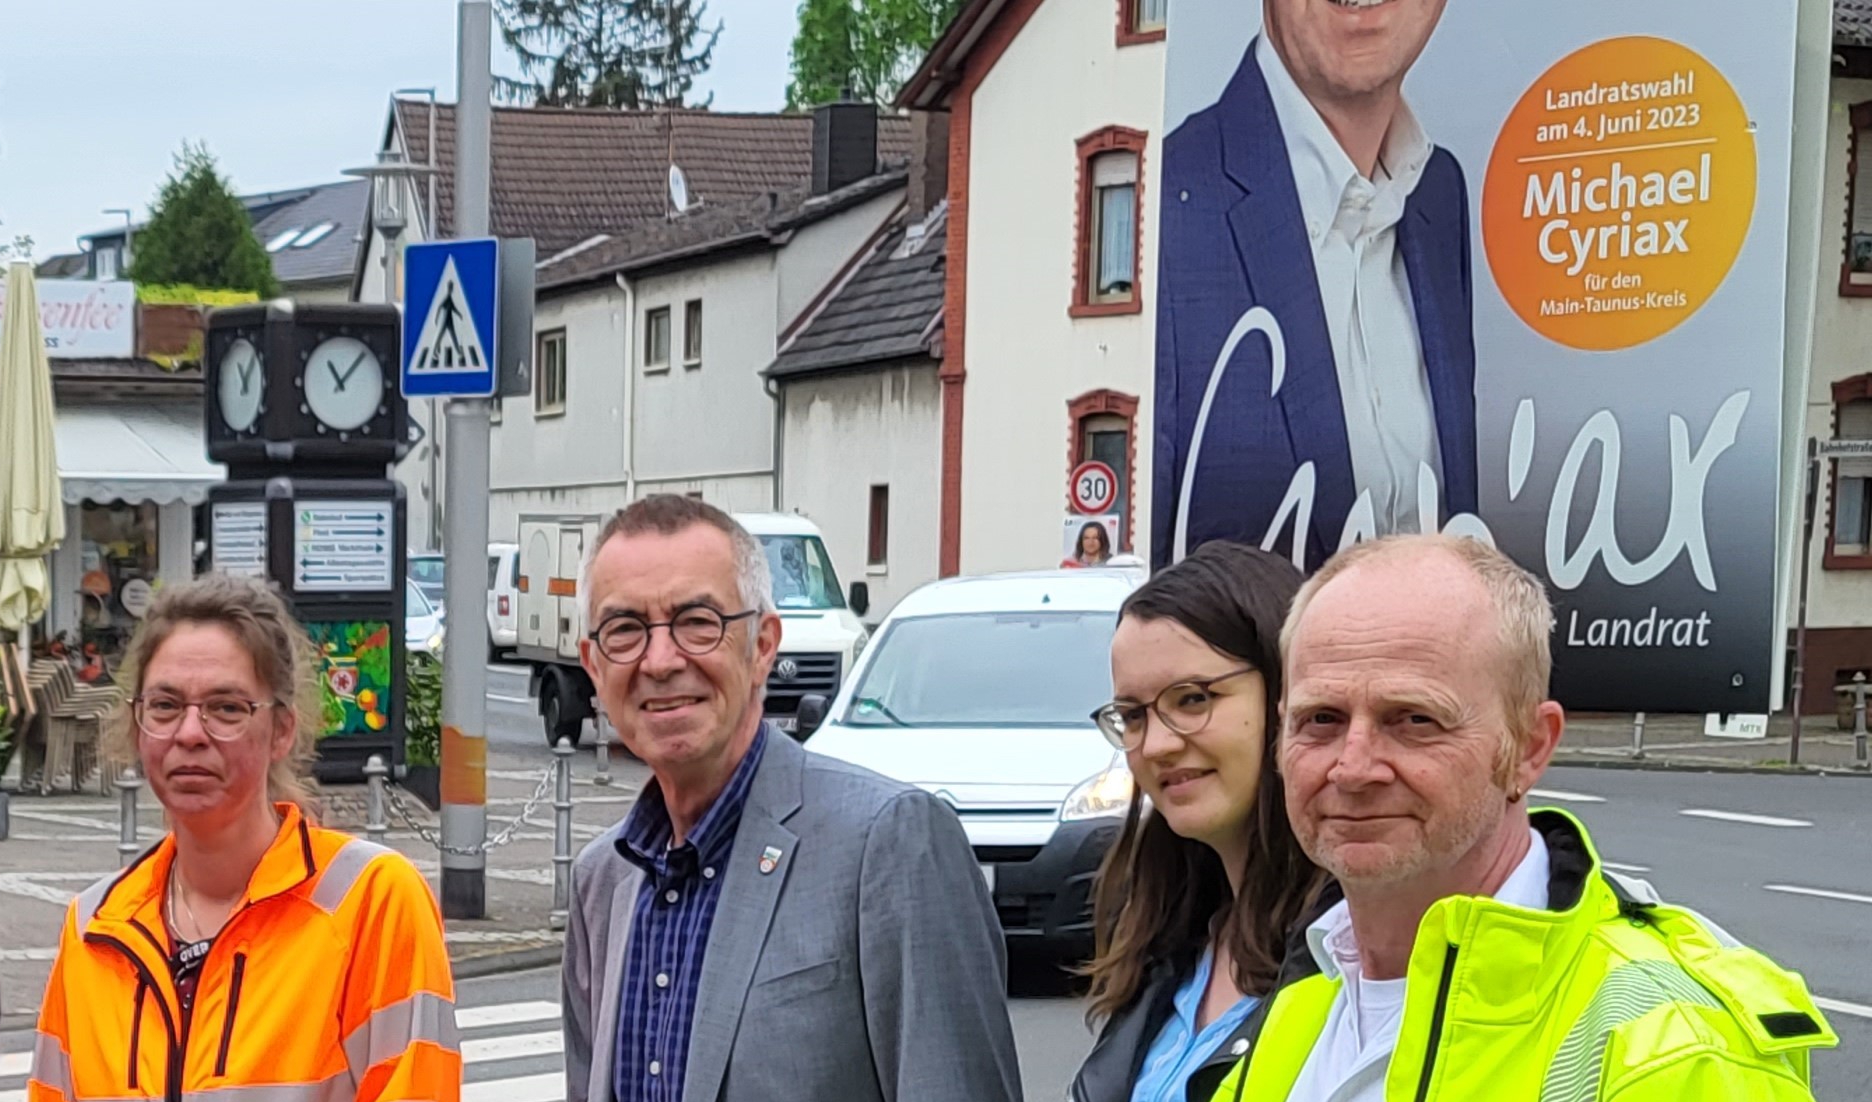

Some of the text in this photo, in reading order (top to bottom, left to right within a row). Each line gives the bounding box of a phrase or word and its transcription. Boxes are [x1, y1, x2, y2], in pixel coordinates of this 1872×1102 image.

[1545, 70, 1695, 111] Landratswahl
[1536, 103, 1701, 142] am 4. Juni 2023
[1523, 152, 1712, 218] Michael
[1538, 211, 1690, 277] Cyriax
[1584, 270, 1642, 292] für den
[1540, 289, 1688, 317] Main-Taunus-Kreis
[1081, 477, 1107, 501] 30
[1567, 606, 1711, 648] Landrat
